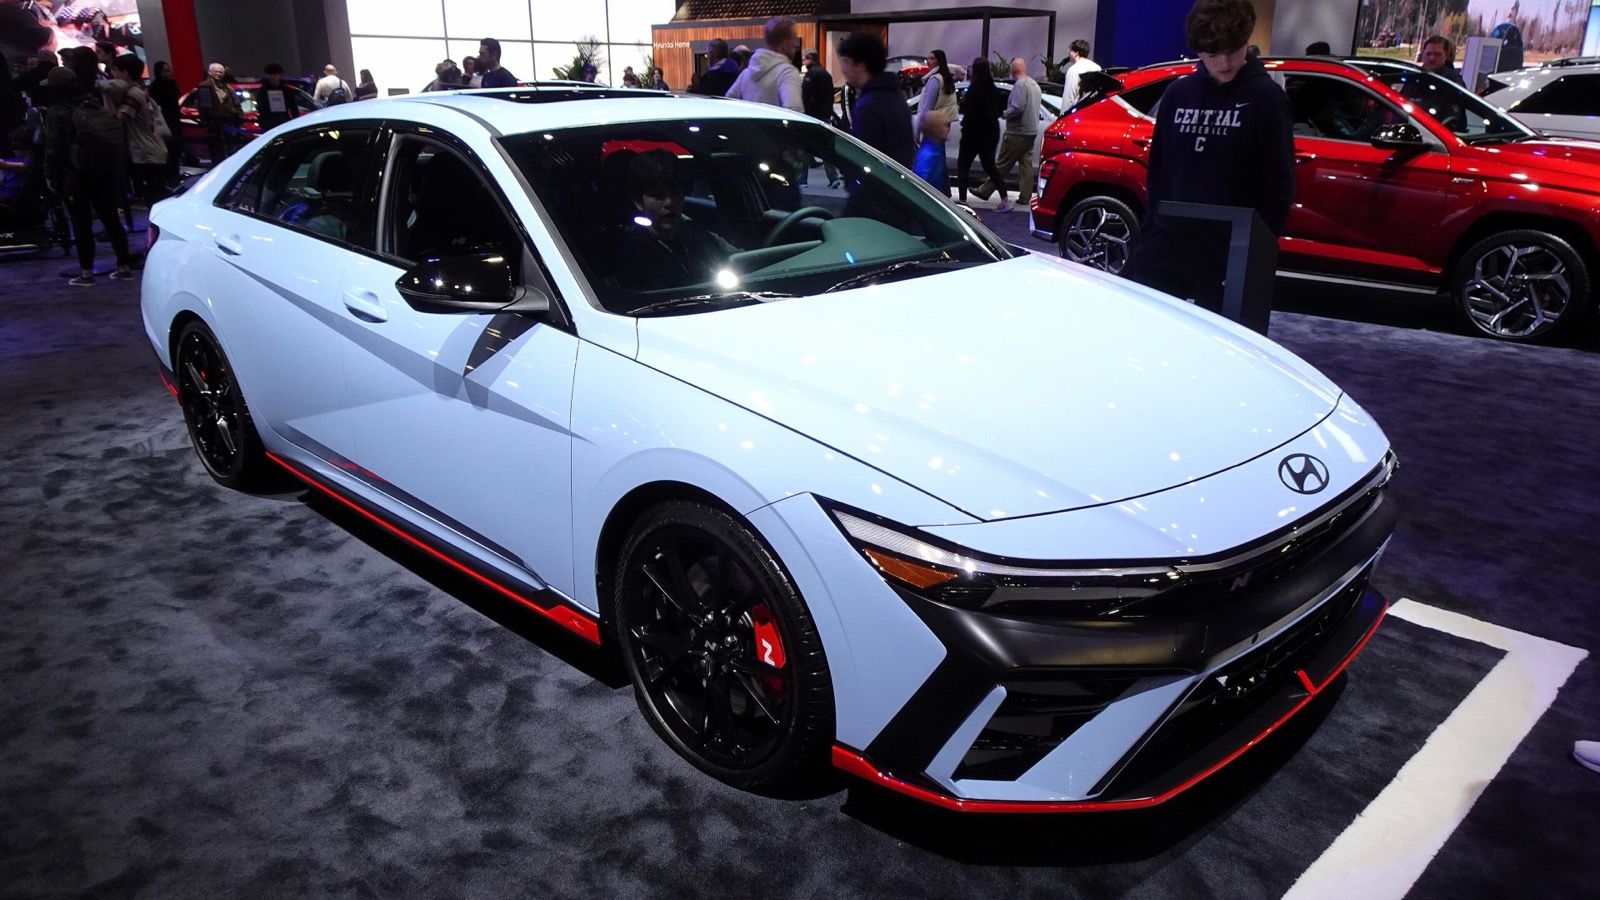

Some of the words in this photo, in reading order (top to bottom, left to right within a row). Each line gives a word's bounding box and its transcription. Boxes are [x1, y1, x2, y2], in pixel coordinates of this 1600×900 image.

[653, 41, 674, 50] Hyundai
[675, 41, 690, 49] Home
[1174, 107, 1242, 127] CENTRAL
[1179, 124, 1228, 136] BASEBALL
[1194, 136, 1206, 152] C
